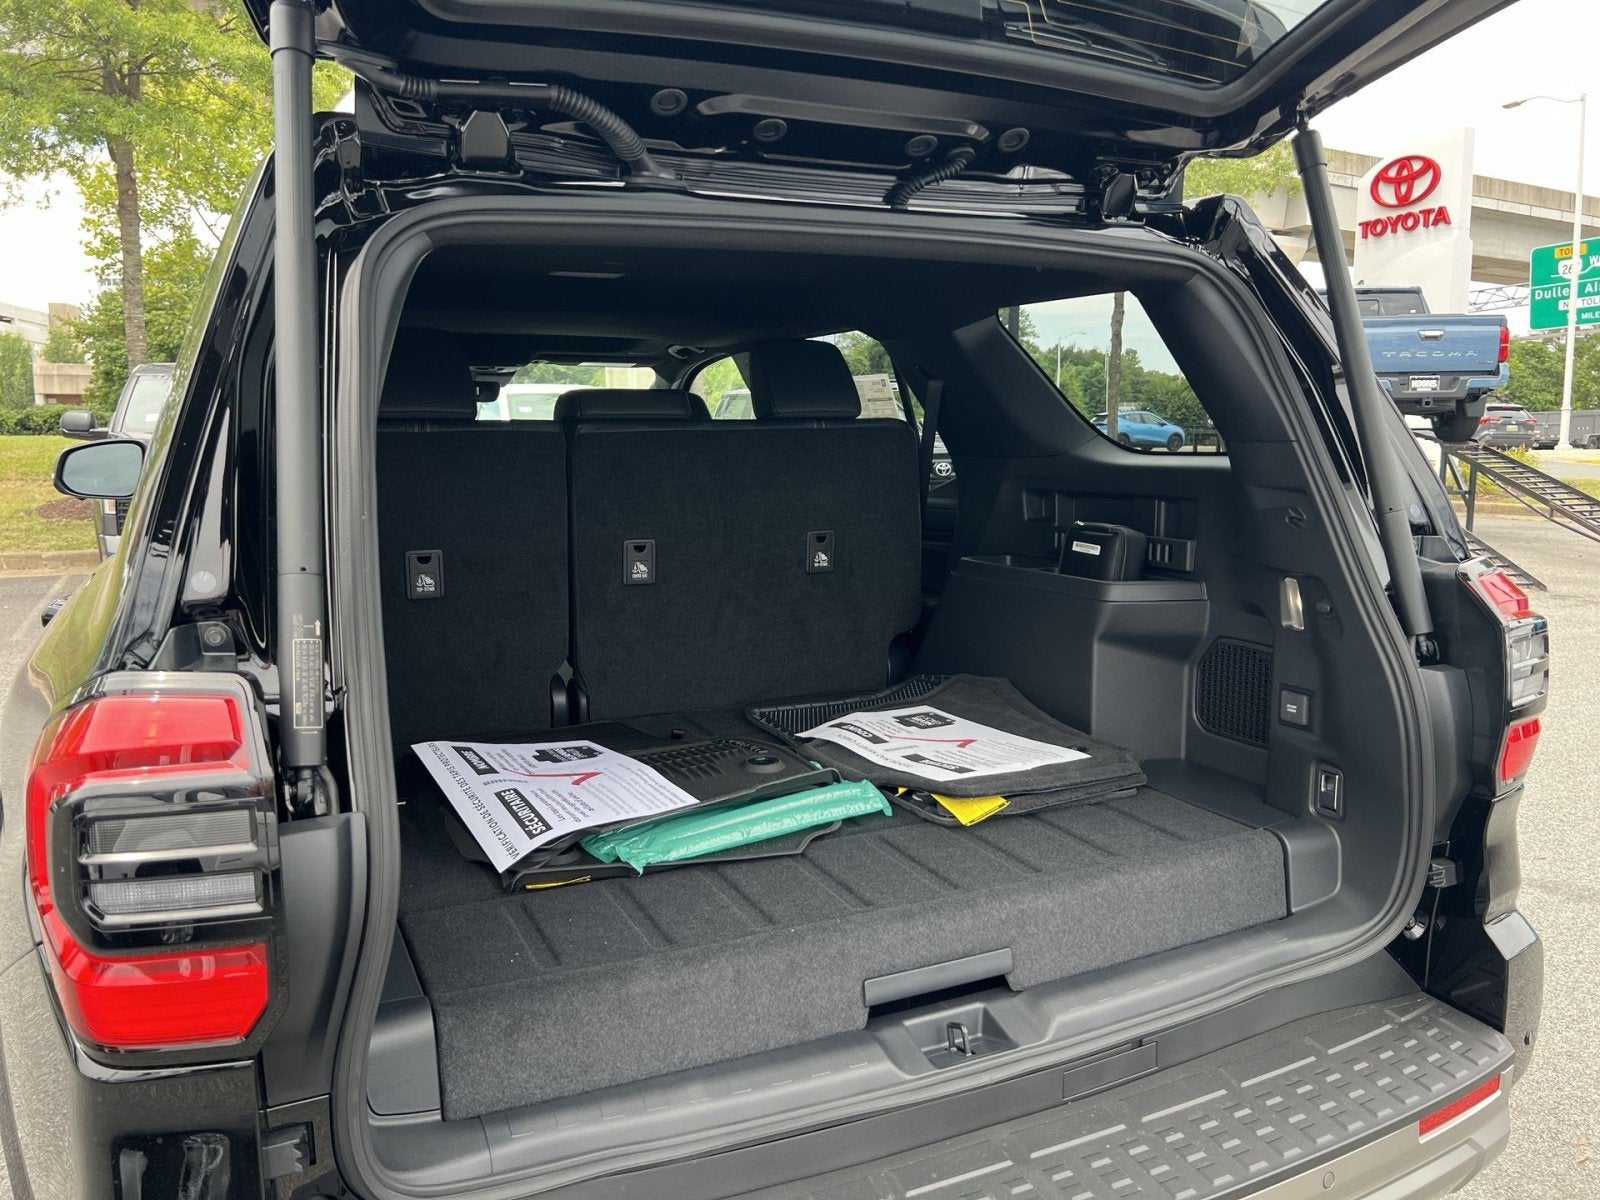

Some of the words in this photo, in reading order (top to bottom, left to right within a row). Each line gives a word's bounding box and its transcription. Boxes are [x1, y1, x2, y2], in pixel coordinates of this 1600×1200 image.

[1358, 206, 1451, 239] TOYOTA
[1535, 285, 1576, 300] Dulle
[1382, 350, 1477, 358] TACOMA
[480, 809, 492, 820] DE
[500, 788, 547, 834] SÉCURITAIRE
